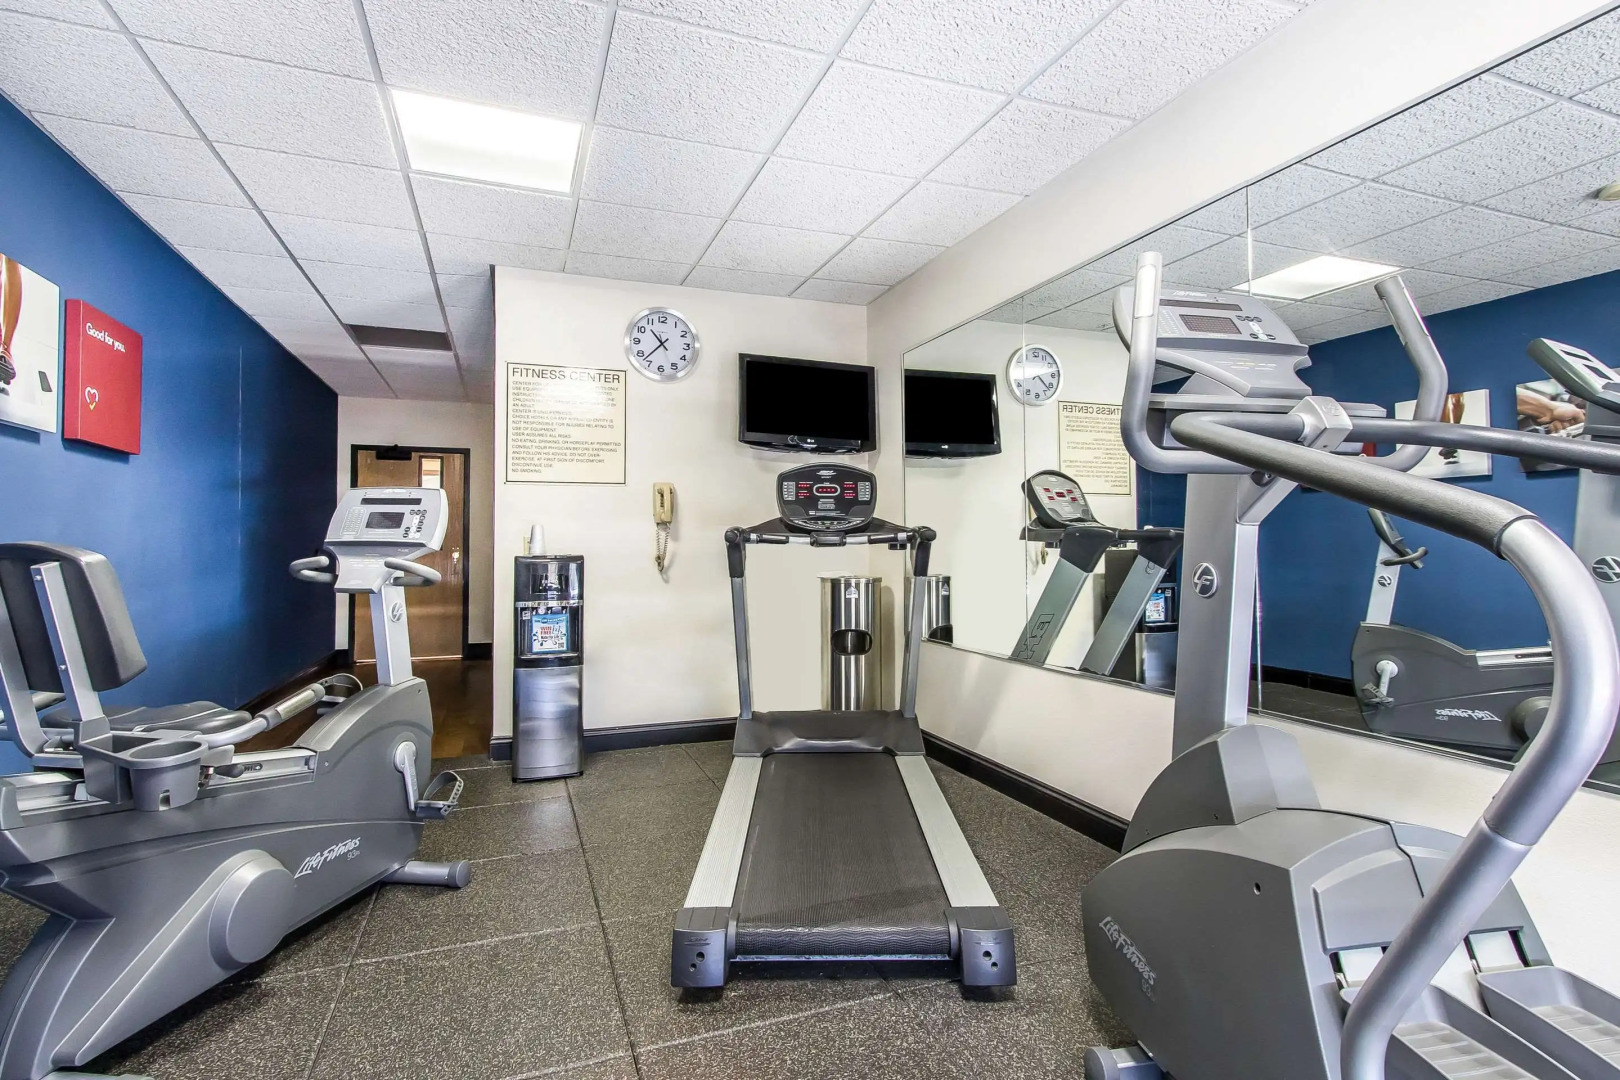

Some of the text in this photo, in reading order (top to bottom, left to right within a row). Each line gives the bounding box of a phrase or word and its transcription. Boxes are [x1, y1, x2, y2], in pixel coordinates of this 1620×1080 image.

[658, 316, 668, 324] 12
[86, 322, 126, 352] Good for you.
[512, 367, 620, 384] FITNESS CENTER
